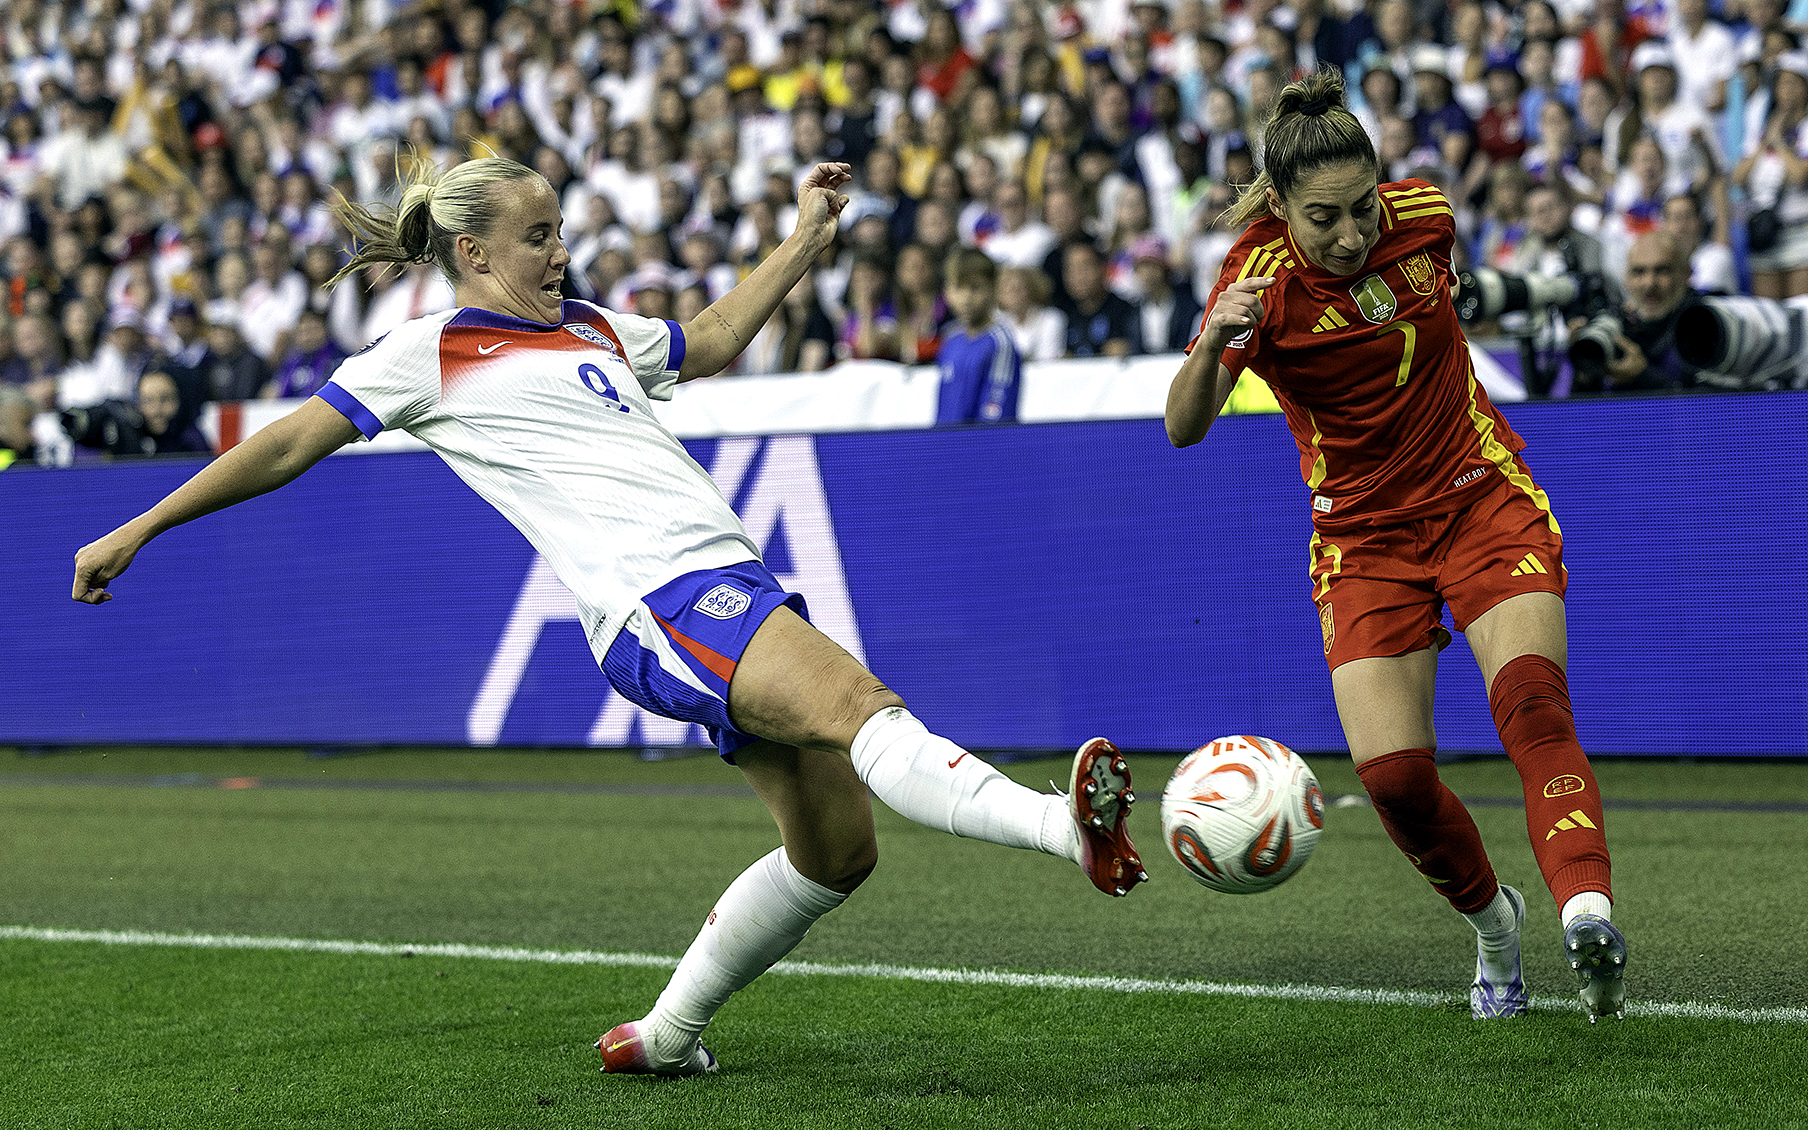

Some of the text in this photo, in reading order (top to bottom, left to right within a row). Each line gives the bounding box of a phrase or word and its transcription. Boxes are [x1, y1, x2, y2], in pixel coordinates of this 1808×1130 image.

[1372, 303, 1389, 316] FIFA
[1376, 320, 1416, 387] 7
[578, 363, 630, 413] 9
[1453, 466, 1487, 488] HEAT.RDY
